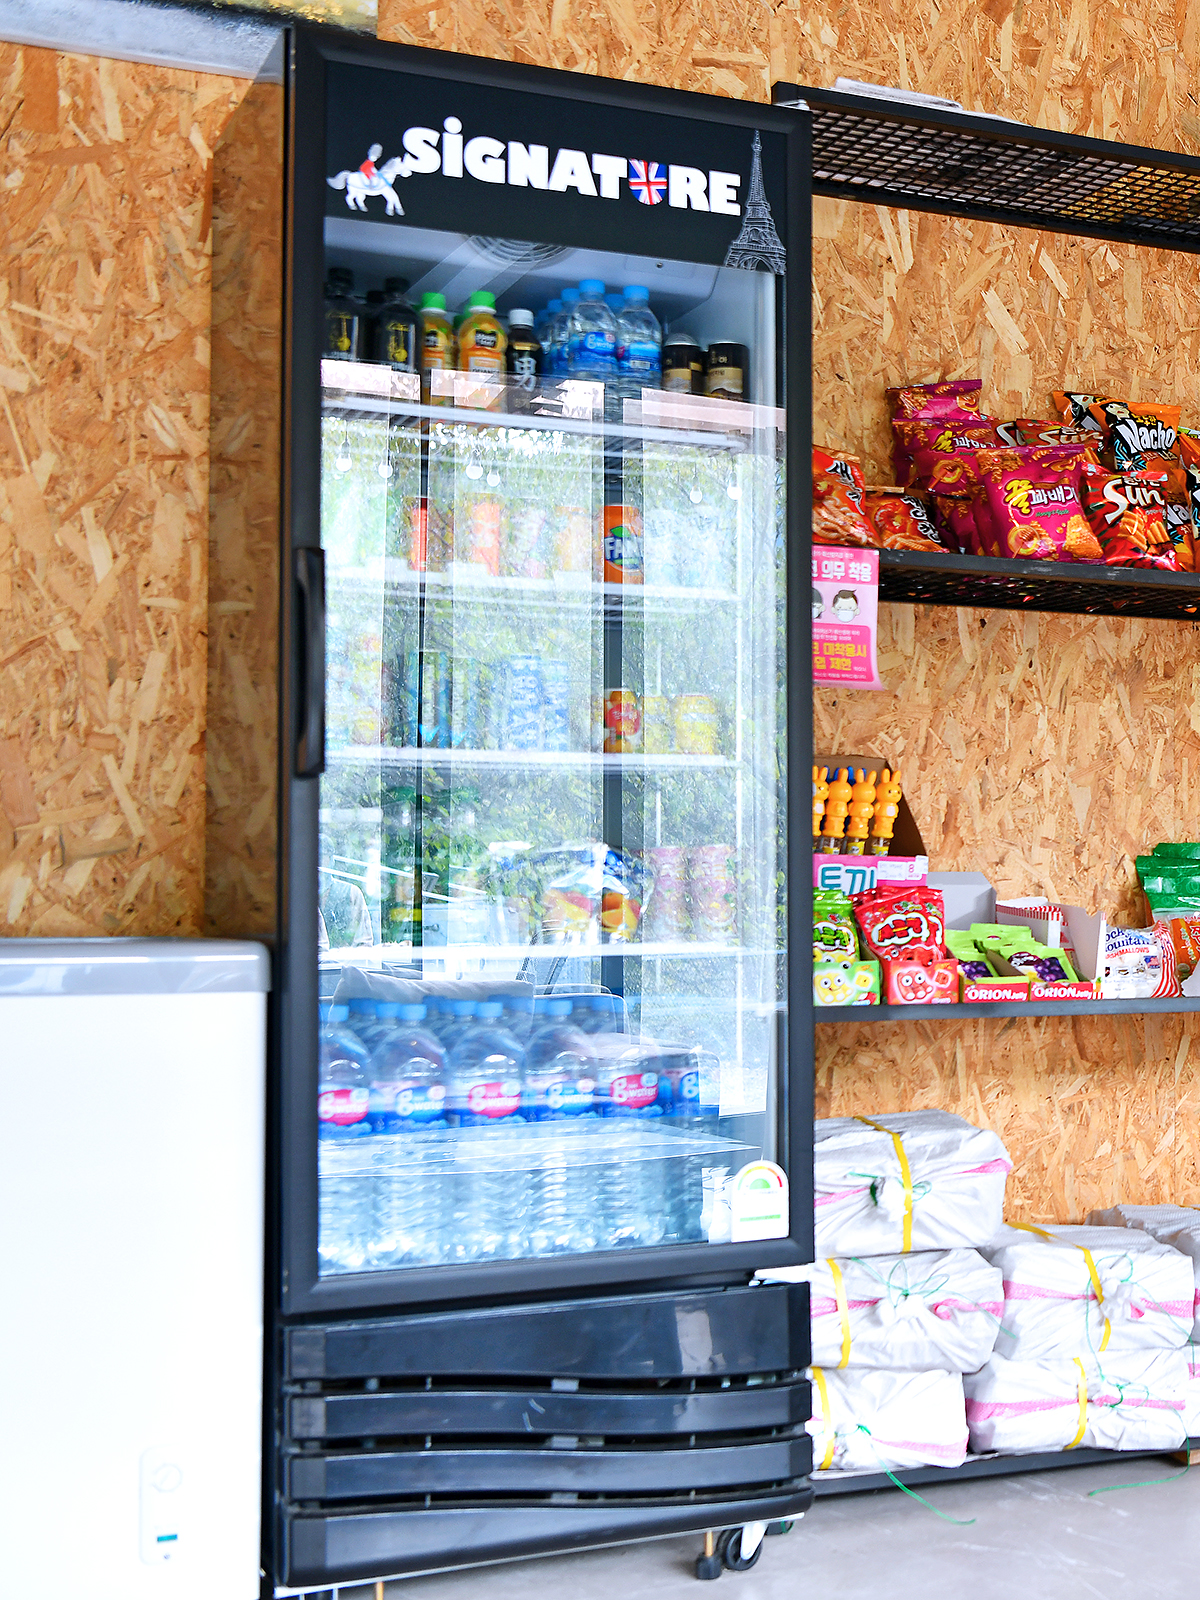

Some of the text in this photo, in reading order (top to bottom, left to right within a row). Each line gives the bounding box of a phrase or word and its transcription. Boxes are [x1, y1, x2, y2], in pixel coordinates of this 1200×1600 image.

[1115, 418, 1176, 453] Nacho
[1103, 480, 1165, 525] Sun
[821, 560, 872, 582] 의무 착용
[823, 642, 867, 658] 미착용시
[829, 657, 852, 671] 제한
[967, 989, 1012, 1000] ORION
[1033, 986, 1076, 998] ORION
